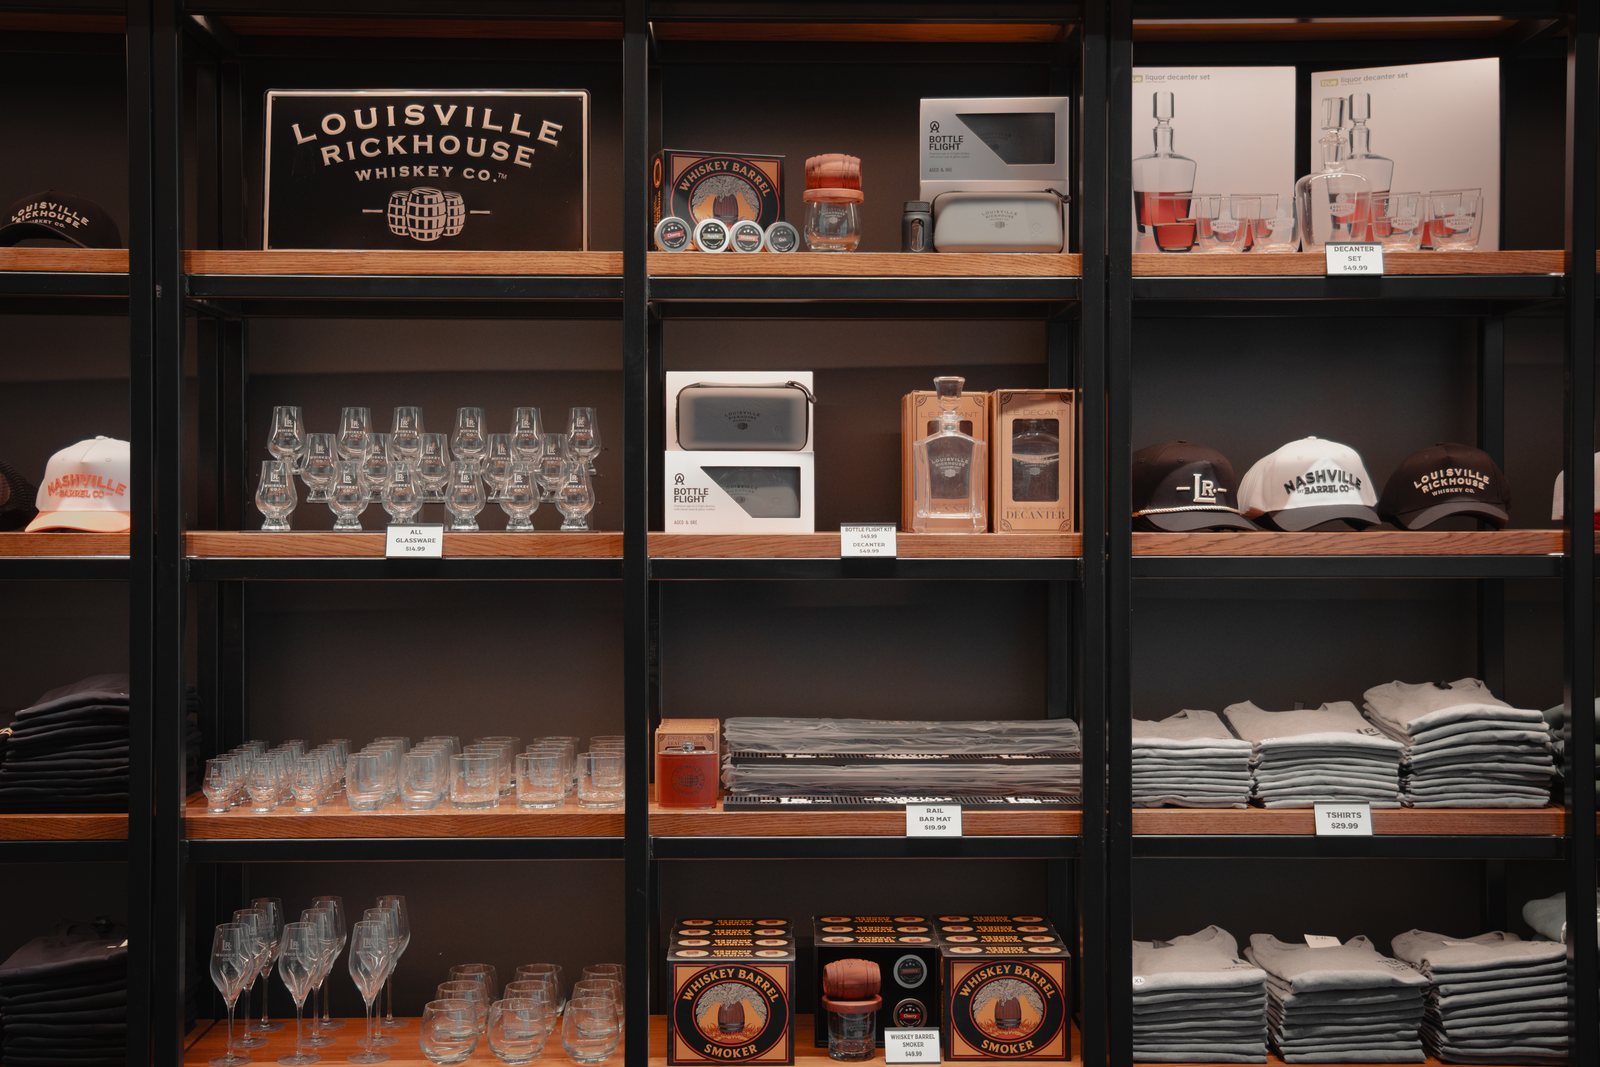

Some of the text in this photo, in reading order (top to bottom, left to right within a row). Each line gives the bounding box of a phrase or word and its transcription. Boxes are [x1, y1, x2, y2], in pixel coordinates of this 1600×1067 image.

[291, 104, 563, 147] LOUISVILLE
[929, 135, 964, 143] BOTTLE
[320, 134, 536, 168] RICKHOUSE
[355, 166, 454, 182] WHISKEY
[679, 160, 771, 198] WHISKEY BARREL
[11, 201, 90, 226] LOUISVILLE
[48, 474, 127, 496] NASHVILLE
[1284, 469, 1362, 494] NASHVILLE
[1414, 468, 1490, 489] LOUISVILLE
[1422, 478, 1485, 494] RICKHOUSE
[674, 488, 709, 496] BOTTLE
[1304, 485, 1338, 494] BARREL
[1432, 488, 1463, 496] WHISKEY
[1006, 511, 1065, 519] DECANTER
[682, 968, 779, 1002] WHISKEY BARREL
[960, 964, 1056, 999] WHISKEY BARREL
[704, 1044, 758, 1058] SMOKER
[981, 1040, 1034, 1054] SMOKER
